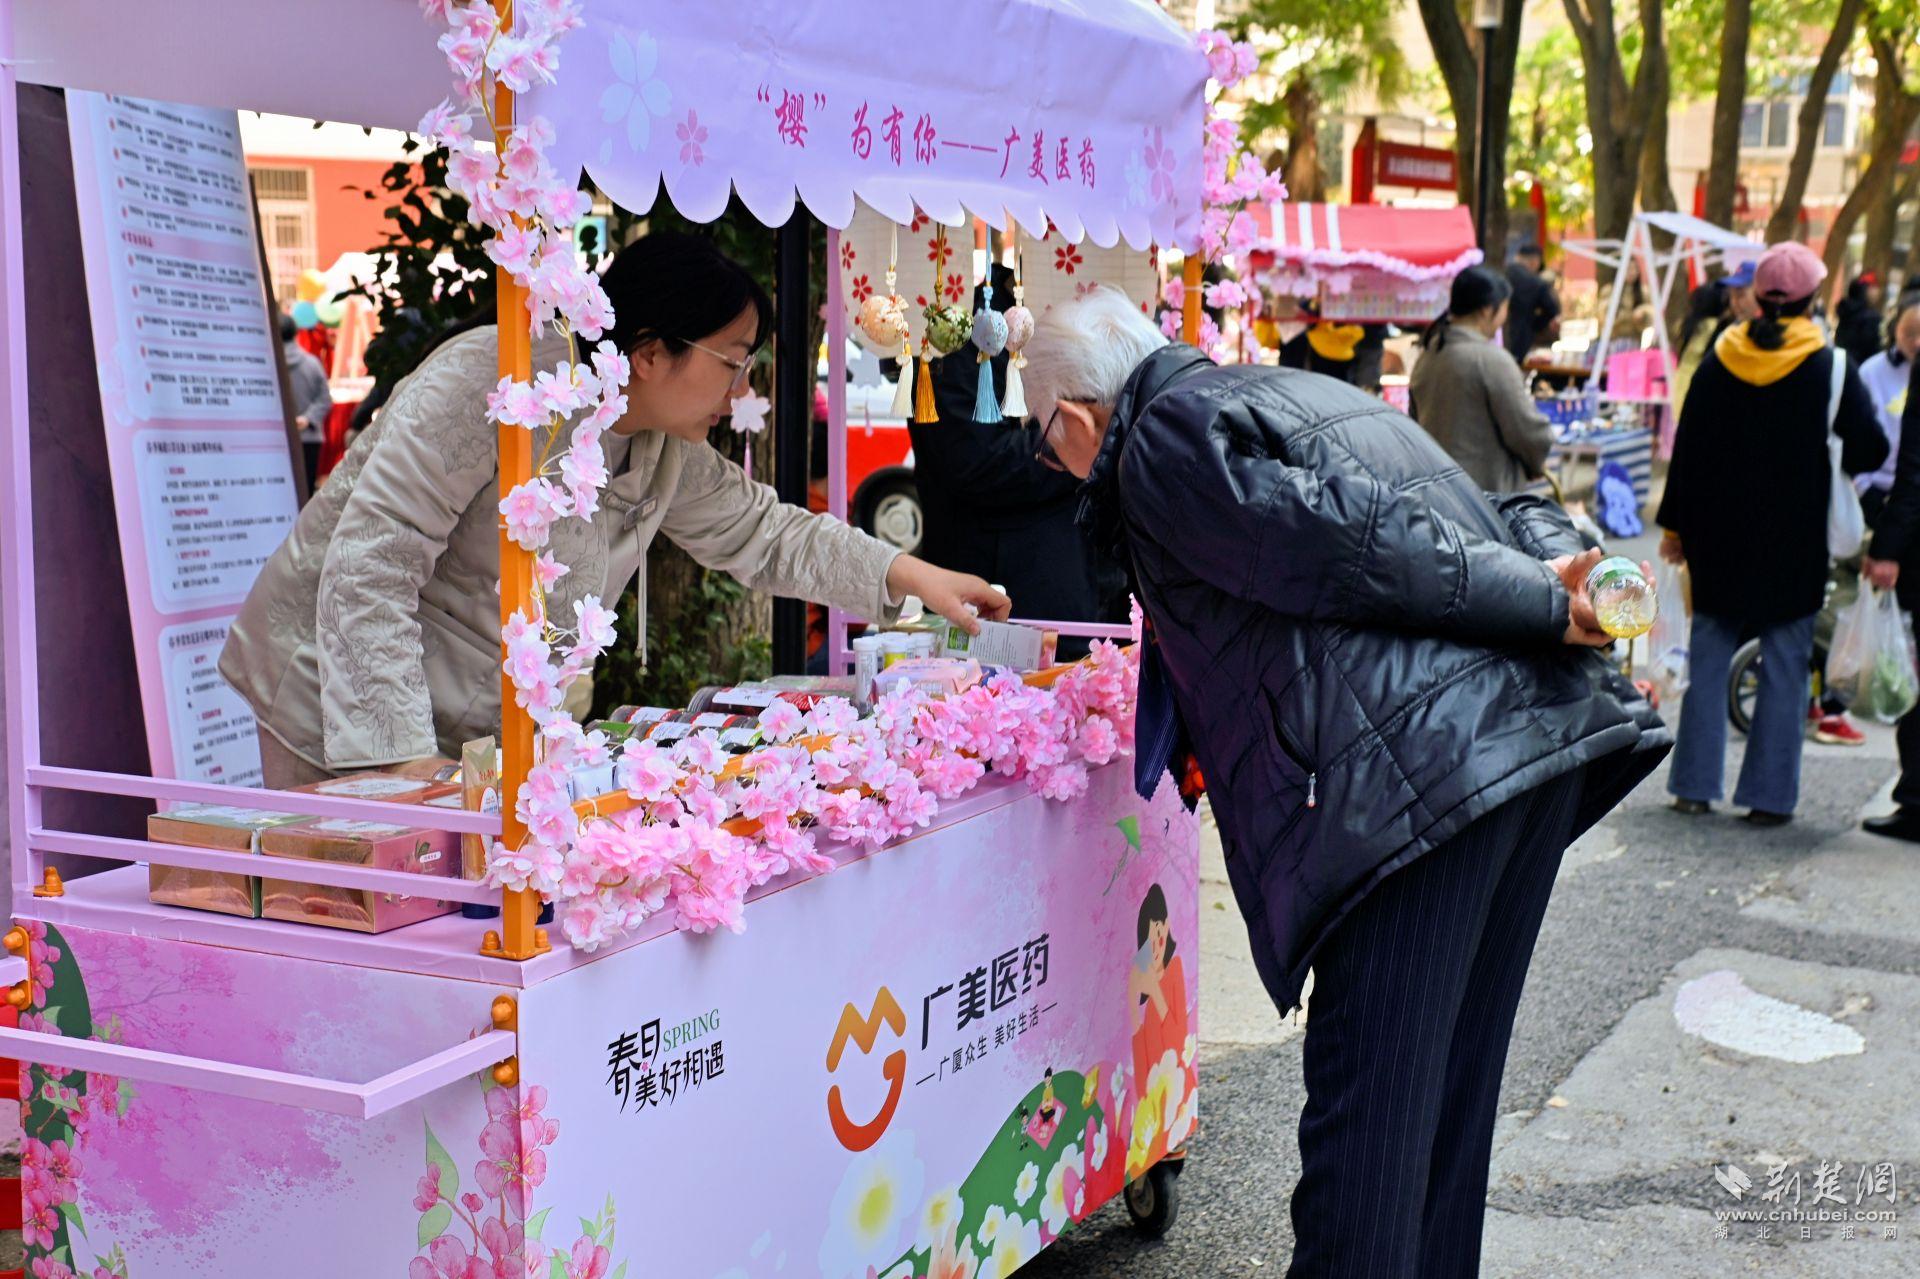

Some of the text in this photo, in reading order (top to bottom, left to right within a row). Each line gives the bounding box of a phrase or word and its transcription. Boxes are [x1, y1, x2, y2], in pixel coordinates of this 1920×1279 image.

[921, 932, 1050, 1051] 广美医药
[663, 1008, 721, 1053] SPRING
[635, 1040, 725, 1114] 美好相遇
